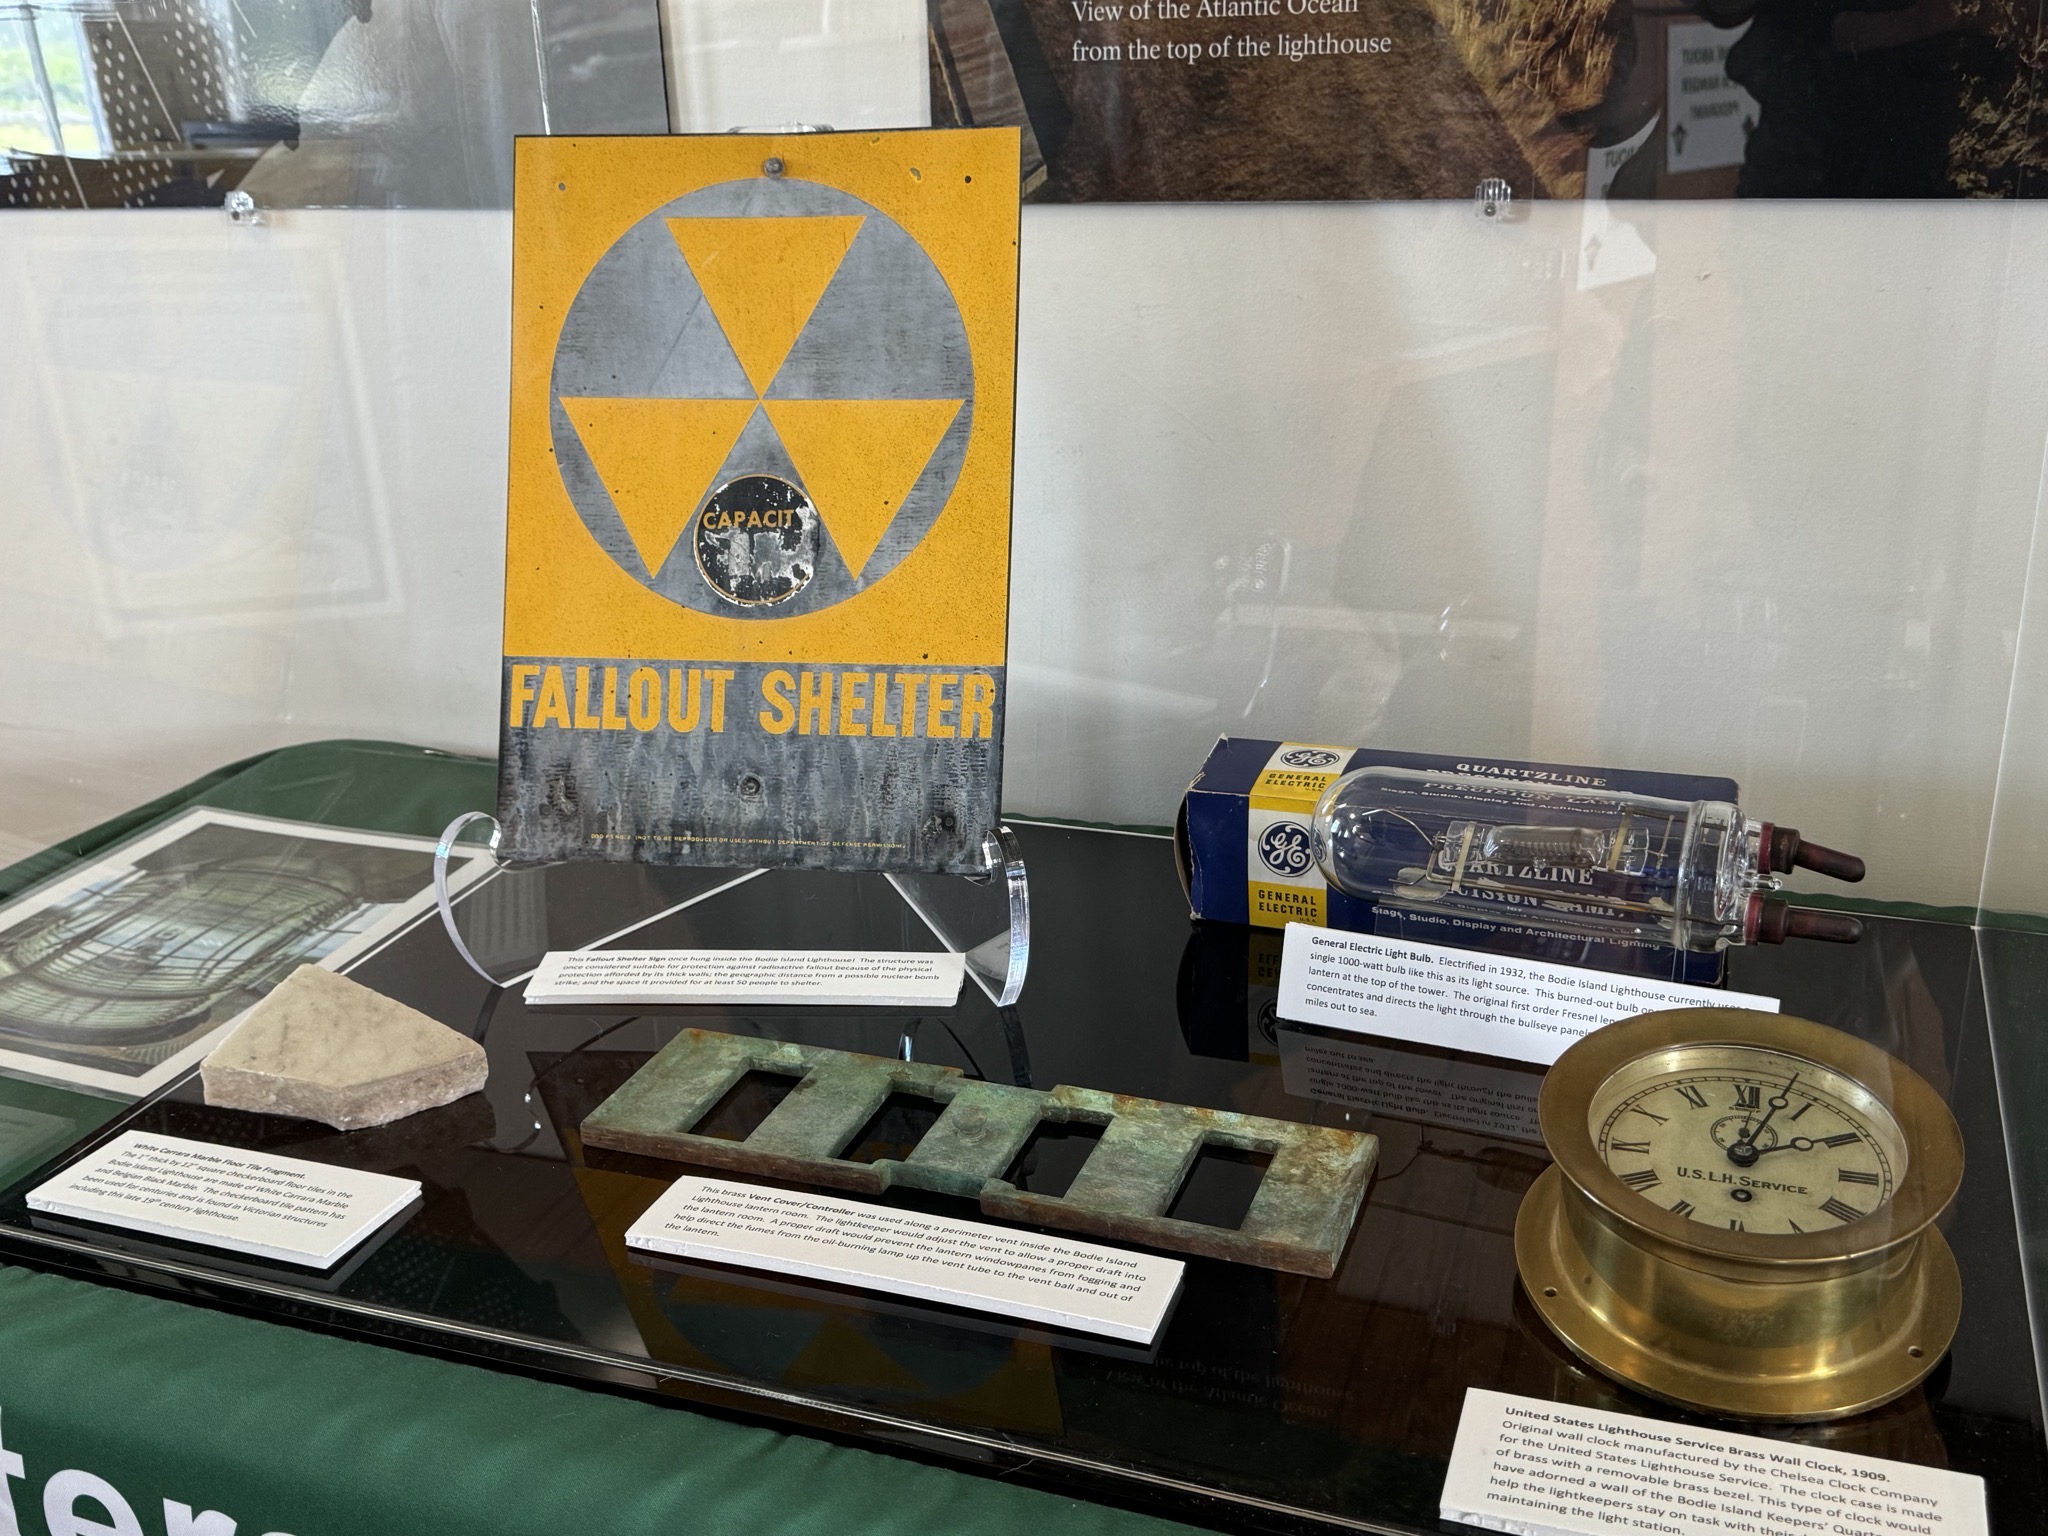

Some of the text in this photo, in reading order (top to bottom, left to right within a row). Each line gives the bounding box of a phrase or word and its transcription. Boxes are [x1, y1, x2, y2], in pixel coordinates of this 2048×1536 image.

[1072, 0, 1359, 22] View of the Atlantic Ocean
[1072, 33, 1391, 64] from the top of the lighthouse
[703, 508, 794, 530] CAPACIT
[510, 665, 996, 738] FALLOUT SHELTER
[1265, 779, 1326, 789] ELECTRIC
[1269, 773, 1327, 782] GENERAL
[1456, 764, 1607, 786] QUARTZLINE
[1258, 889, 1316, 906] GENERAL
[1259, 902, 1317, 917] ELECTRIC
[1372, 906, 1406, 921] Stage,
[1410, 912, 1450, 926] Studio,
[1452, 918, 1497, 932] Display
[1500, 924, 1522, 934] and
[1526, 928, 1605, 944] Architectural
[1310, 951, 1336, 964] single
[1337, 956, 1384, 971] 1000-watt
[1385, 963, 1406, 975] bulb
[1408, 967, 1424, 978] like
[1426, 970, 1443, 981] this
[1445, 975, 1456, 983] as
[1458, 976, 1469, 985] its
[1471, 977, 1493, 989] light
[1494, 983, 1529, 995] source.
[1535, 987, 1554, 999] This
[1557, 991, 1614, 1009] burned-out
[1616, 1001, 1638, 1013] bulb
[1311, 936, 1347, 949] General
[1349, 942, 1383, 955] Electric
[1384, 947, 1408, 960] Light
[1409, 951, 1434, 964] Bulb.
[1438, 956, 1486, 972] Electrified
[1499, 966, 1526, 980] 1932,
[1529, 971, 1545, 981] the
[1547, 974, 1576, 986] Bodie
[1578, 979, 1608, 991] Island
[1610, 984, 1666, 1001] Lighthouse
[1667, 995, 1716, 1011] currently
[1674, 1086, 1710, 1110] XI
[1732, 1084, 1761, 1109] XII
[1630, 1104, 1670, 1126] X
[1788, 1102, 1815, 1122] I
[1611, 1136, 1651, 1156] IX
[133, 1143, 159, 1152] White
[159, 1147, 191, 1157] Carrara
[190, 1153, 222, 1163] Marble
[221, 1159, 246, 1167] Floor
[262, 1166, 306, 1180] Fragment.
[107, 1158, 133, 1168] Bodie
[131, 1163, 160, 1172] Island
[157, 1167, 204, 1180] Lighthouse
[218, 1180, 244, 1189] made
[255, 1186, 282, 1196] White
[282, 1191, 316, 1202] Carrara
[315, 1198, 349, 1209] Marble
[1739, 1176, 1808, 1195] SERVICE
[1838, 1168, 1878, 1188] III
[720, 1189, 747, 1198] brass
[748, 1193, 772, 1202] Vent
[773, 1197, 856, 1216] Cover/Controller
[878, 1216, 903, 1224] used
[903, 1220, 932, 1230] along
[940, 1227, 993, 1240] perimeter
[995, 1236, 1018, 1245] vent
[1019, 1240, 1050, 1251] inside
[1053, 1247, 1071, 1255] the
[1072, 1250, 1103, 1262] Bodie
[1105, 1257, 1138, 1268] Island
[1505, 1407, 1890, 1482] United States Lighthouse Service Brass Wall Clock, 1909.
[1502, 1420, 1938, 1507] Original wall clock manufactured by the Chelsea Clock Company
[1499, 1433, 1942, 1522] for the United States Lighthouse Service. The clock case is made
